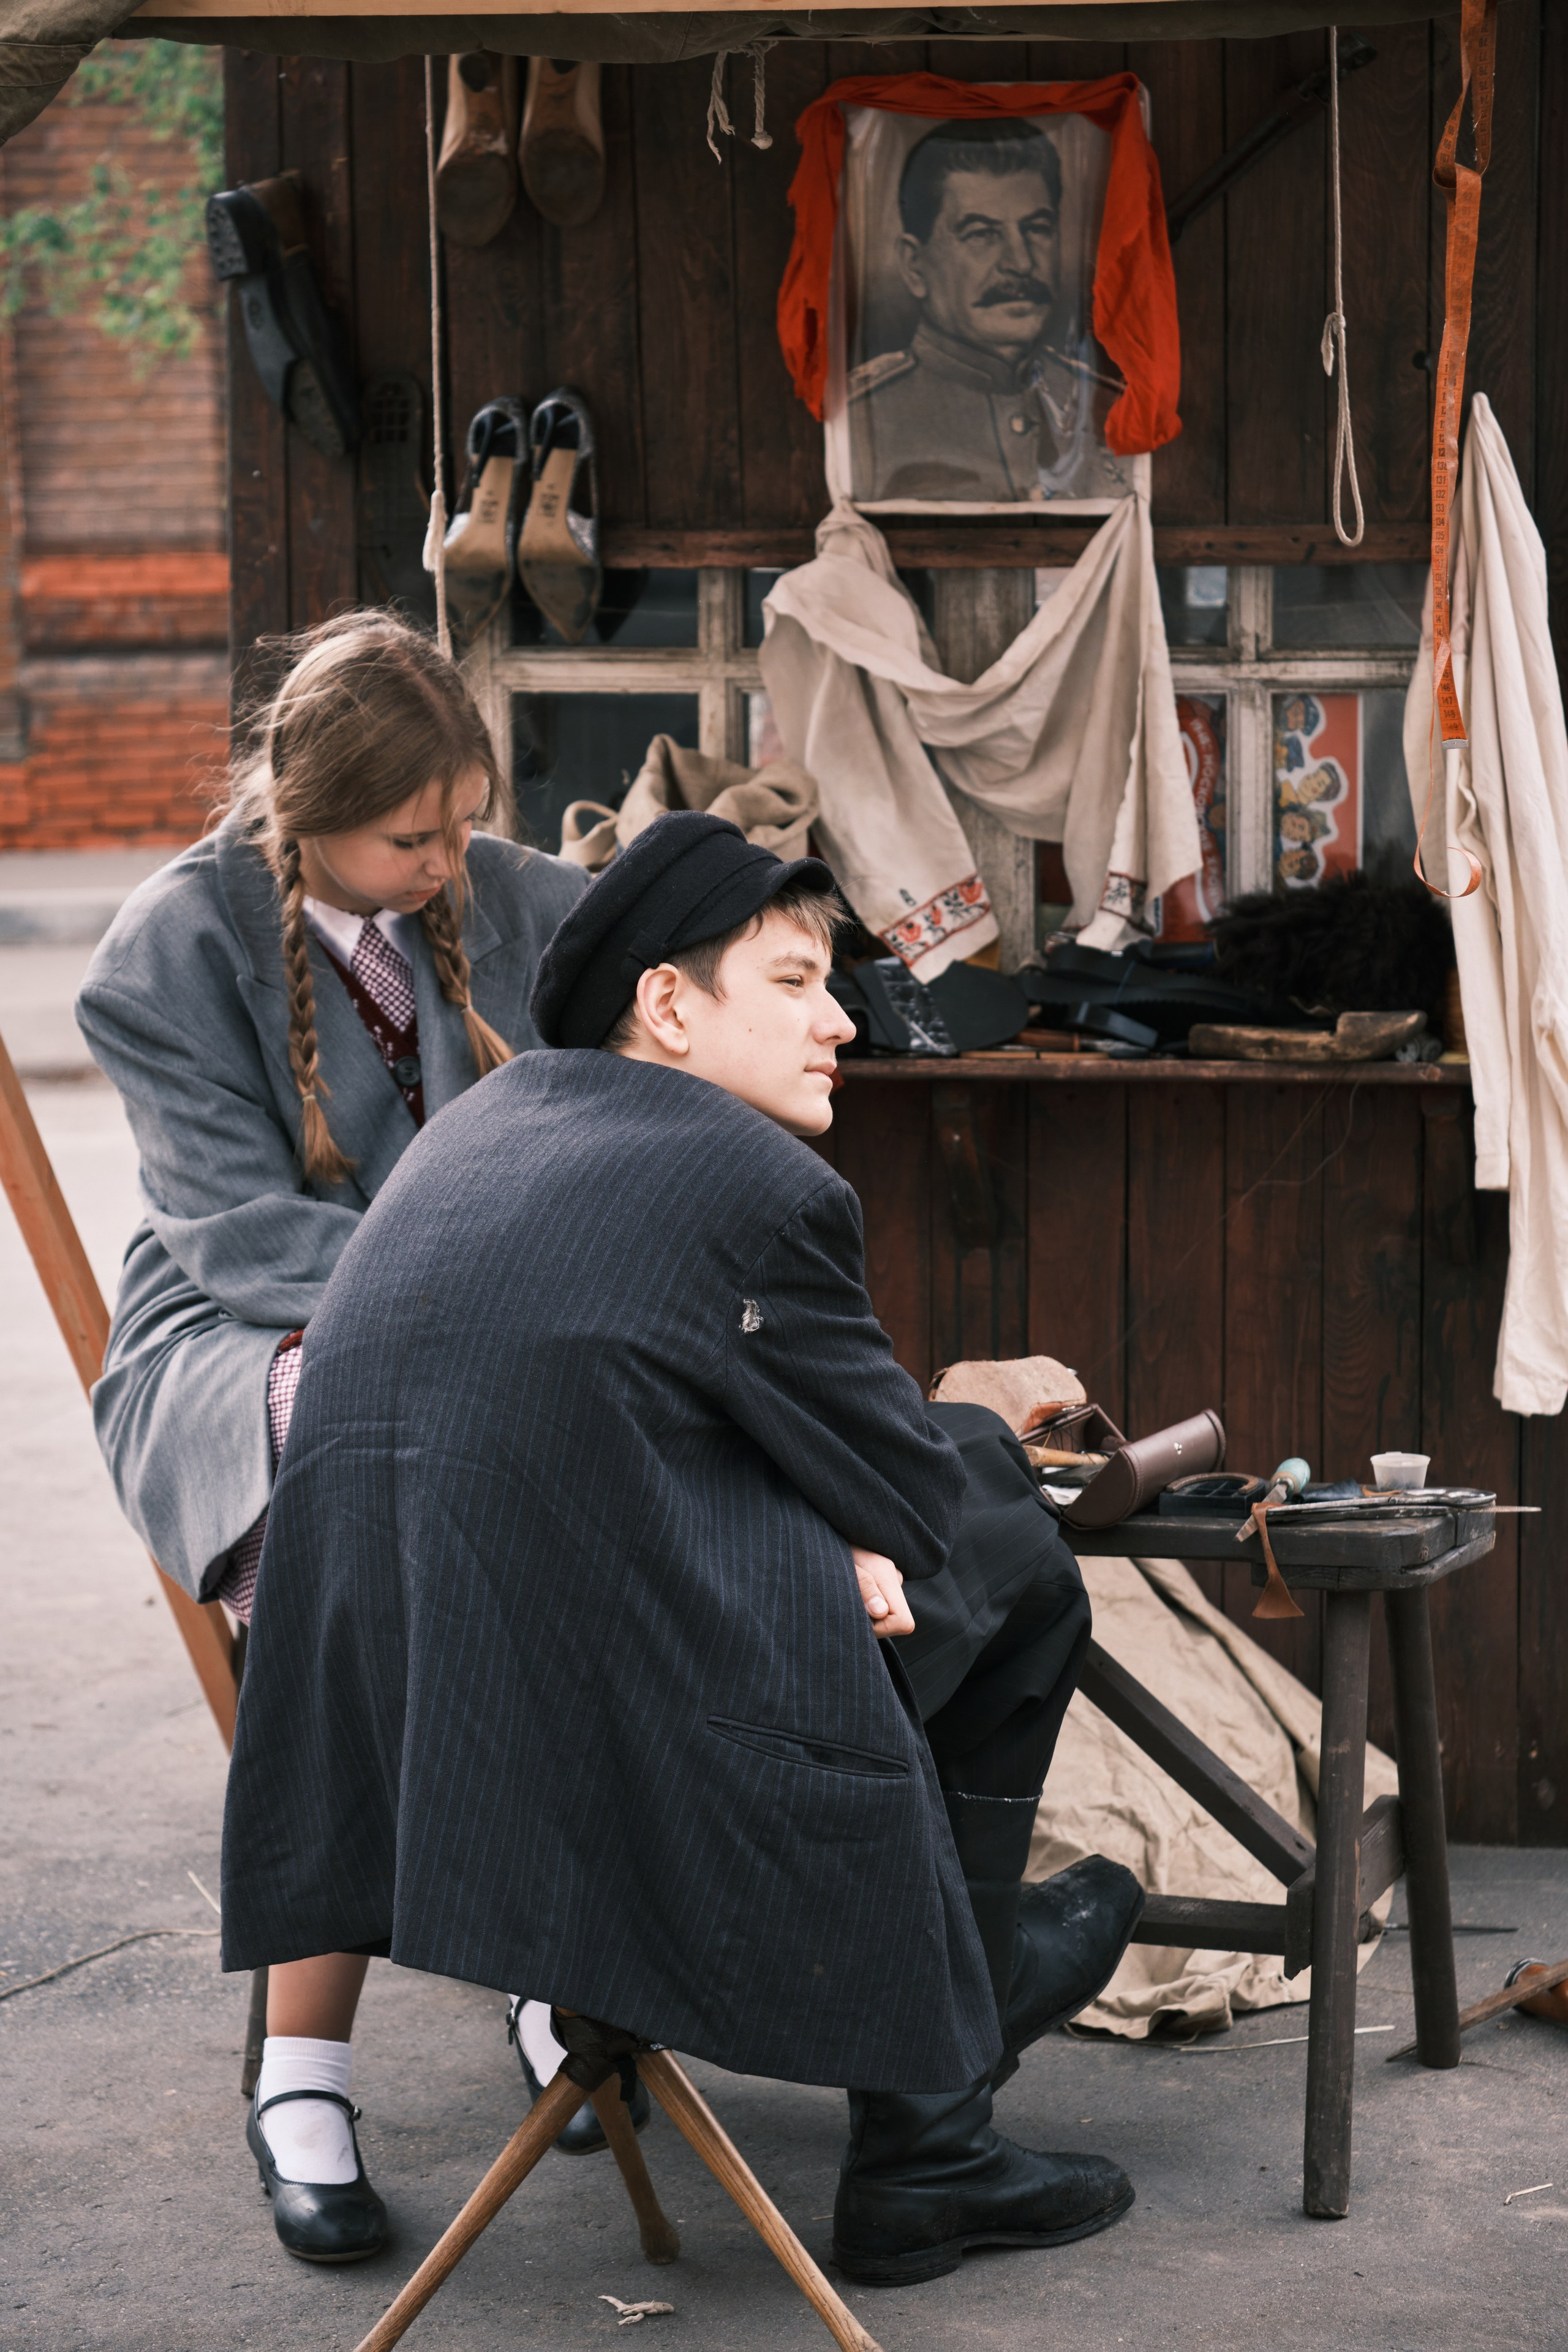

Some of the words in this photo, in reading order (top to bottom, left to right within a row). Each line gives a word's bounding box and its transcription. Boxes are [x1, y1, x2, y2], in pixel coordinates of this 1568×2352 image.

[1436, 475, 1446, 484] 131
[1436, 490, 1446, 499] 132
[1436, 503, 1445, 513] 133
[1436, 517, 1445, 526] 134
[1436, 531, 1444, 540] 135
[1435, 545, 1444, 554] 136
[1441, 683, 1451, 692] 146
[1442, 696, 1452, 705] 147
